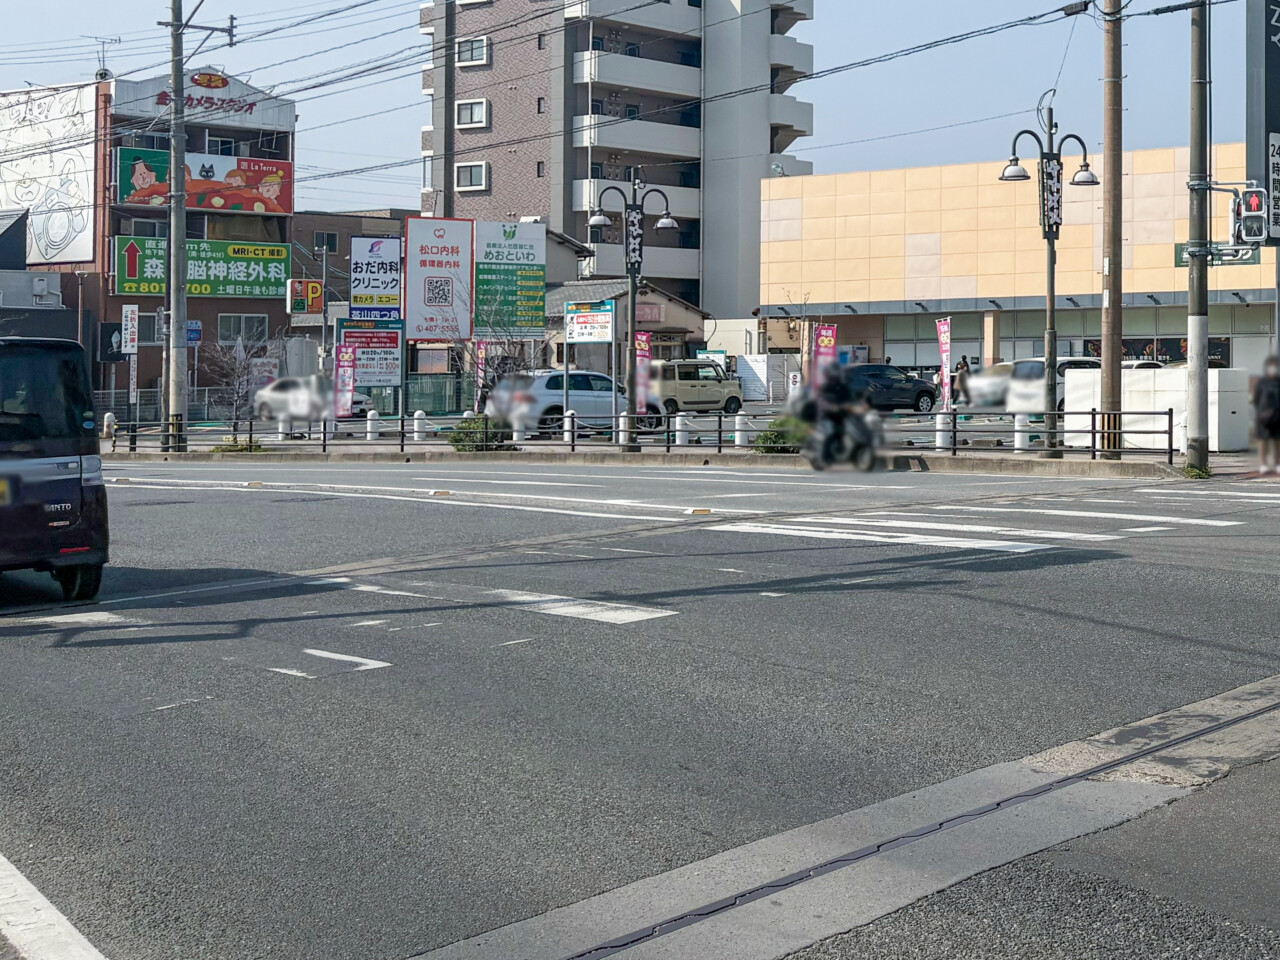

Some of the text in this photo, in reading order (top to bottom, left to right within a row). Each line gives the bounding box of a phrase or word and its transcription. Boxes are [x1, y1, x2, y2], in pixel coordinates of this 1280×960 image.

[251, 162, 259, 171] La
[260, 163, 277, 172] Terra
[484, 250, 536, 262] めおといわ
[143, 257, 287, 282] 森脳神経外科
[352, 260, 400, 275] おだ内科
[351, 276, 399, 290] クリニック
[307, 282, 323, 306] P
[45, 503, 72, 512] ANTO
